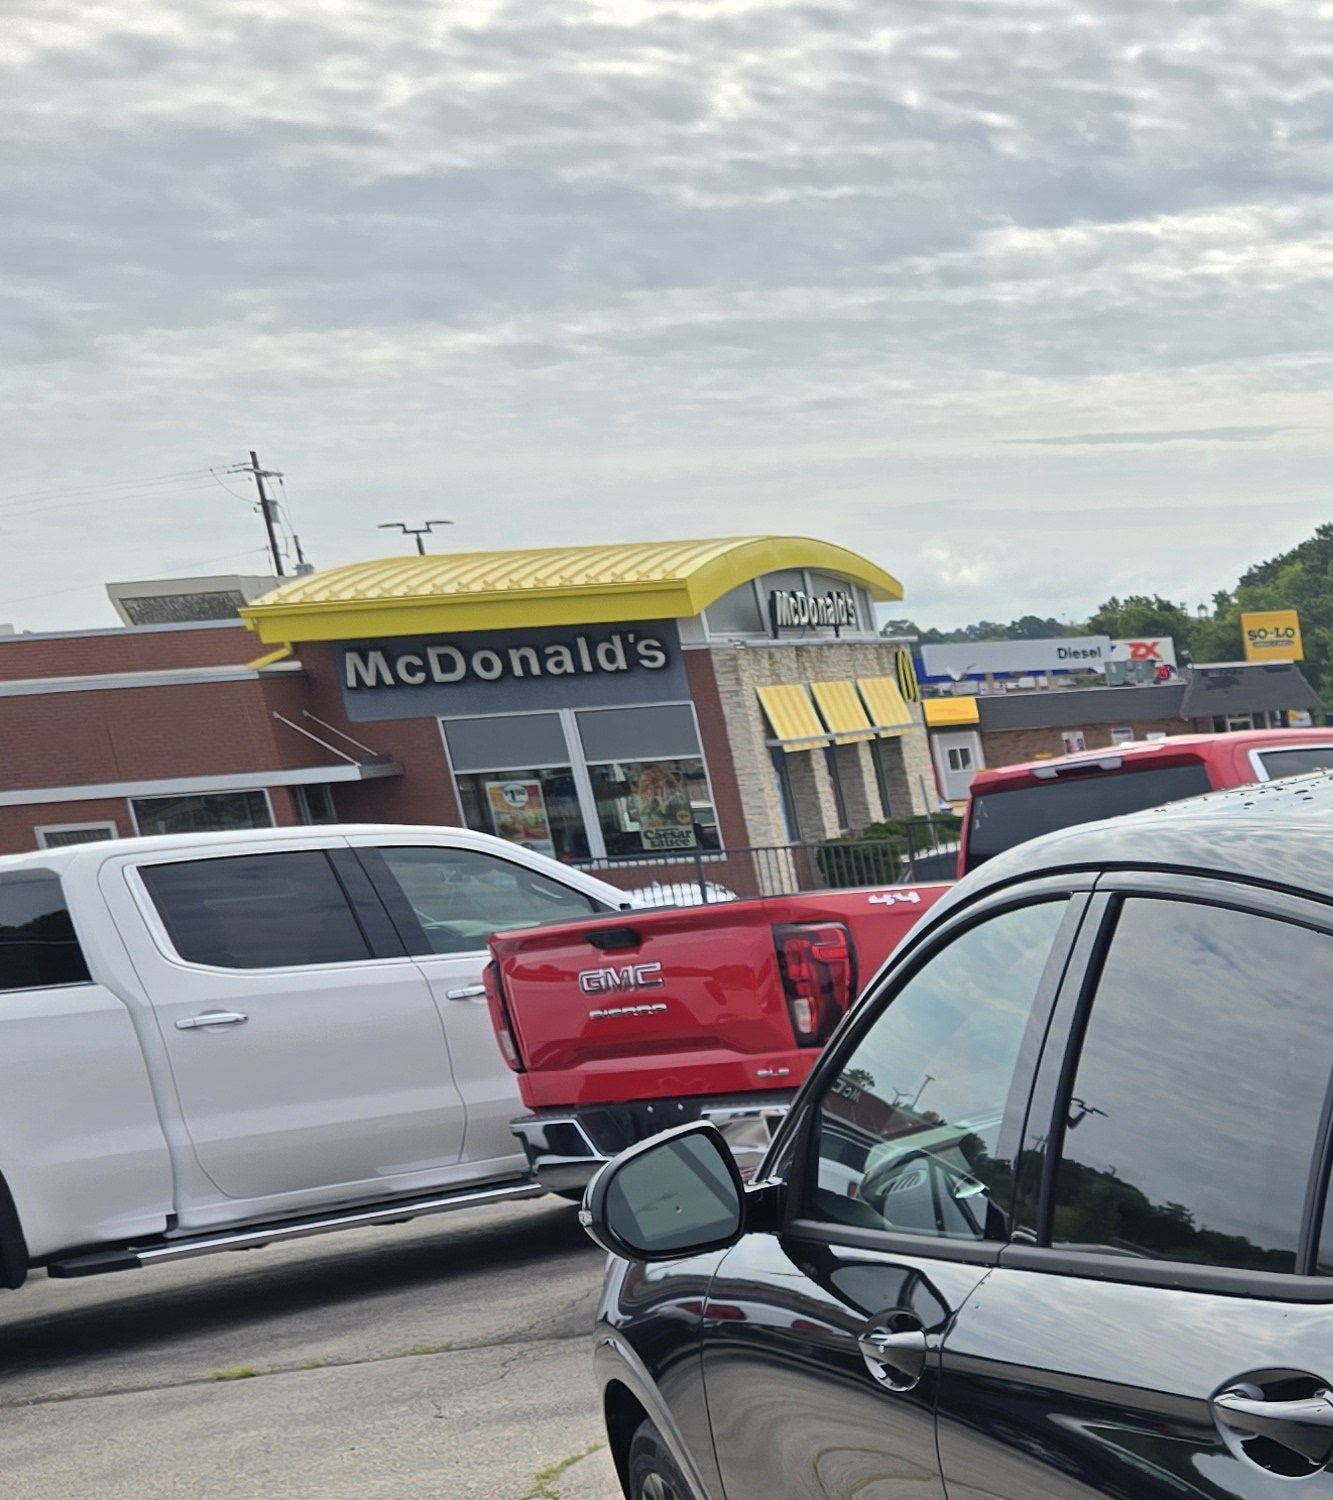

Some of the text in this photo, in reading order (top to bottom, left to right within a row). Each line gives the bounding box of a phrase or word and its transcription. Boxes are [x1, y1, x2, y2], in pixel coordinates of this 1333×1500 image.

[775, 590, 857, 626] McDonald's
[1247, 626, 1296, 641] SO-LO
[345, 633, 667, 688] McDonald's
[1057, 645, 1102, 660] Diesel
[578, 961, 664, 995] GMC
